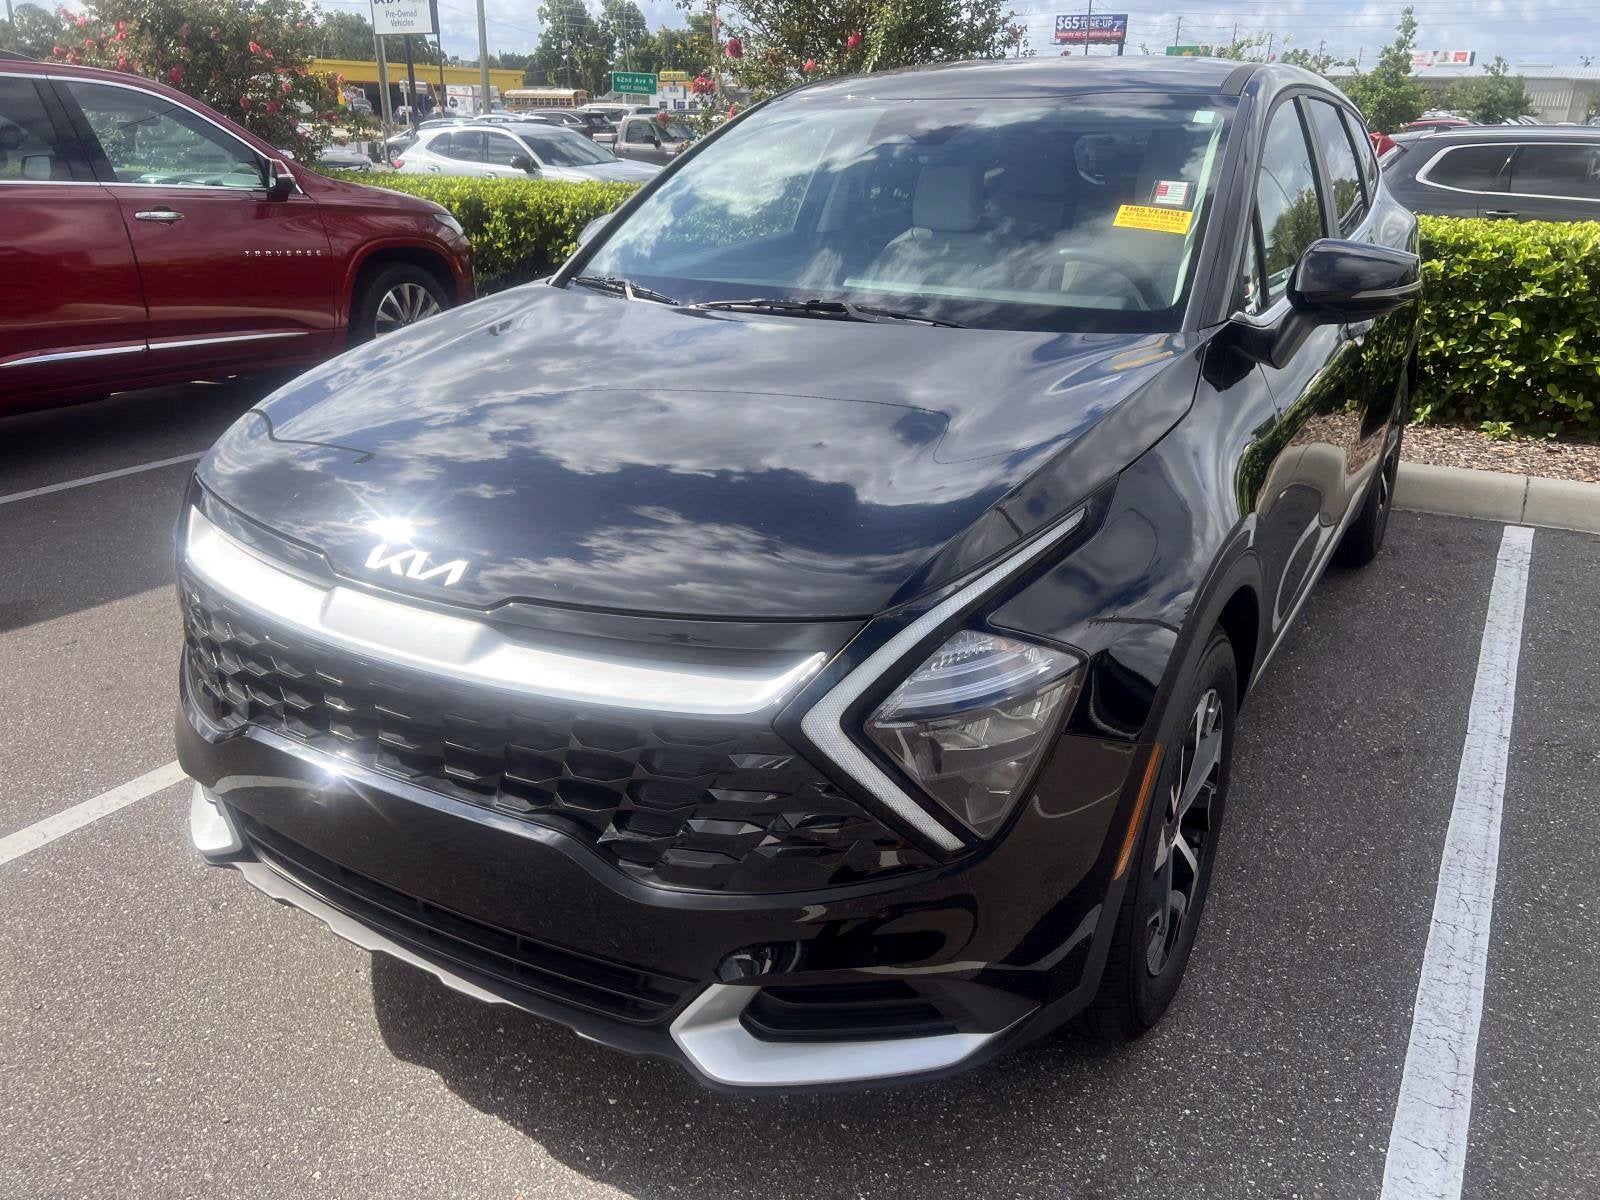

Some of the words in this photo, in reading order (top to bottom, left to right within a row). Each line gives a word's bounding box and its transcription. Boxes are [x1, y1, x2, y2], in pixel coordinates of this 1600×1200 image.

[385, 9, 418, 18] Pre-Owned
[390, 18, 415, 27] Vehicles
[1056, 15, 1080, 30] $65
[616, 75, 633, 83] 62nd
[634, 76, 647, 84] Ave
[1148, 208, 1188, 218] VEHICLE
[244, 249, 322, 257] TRAVERSE
[364, 543, 470, 587] KIA
